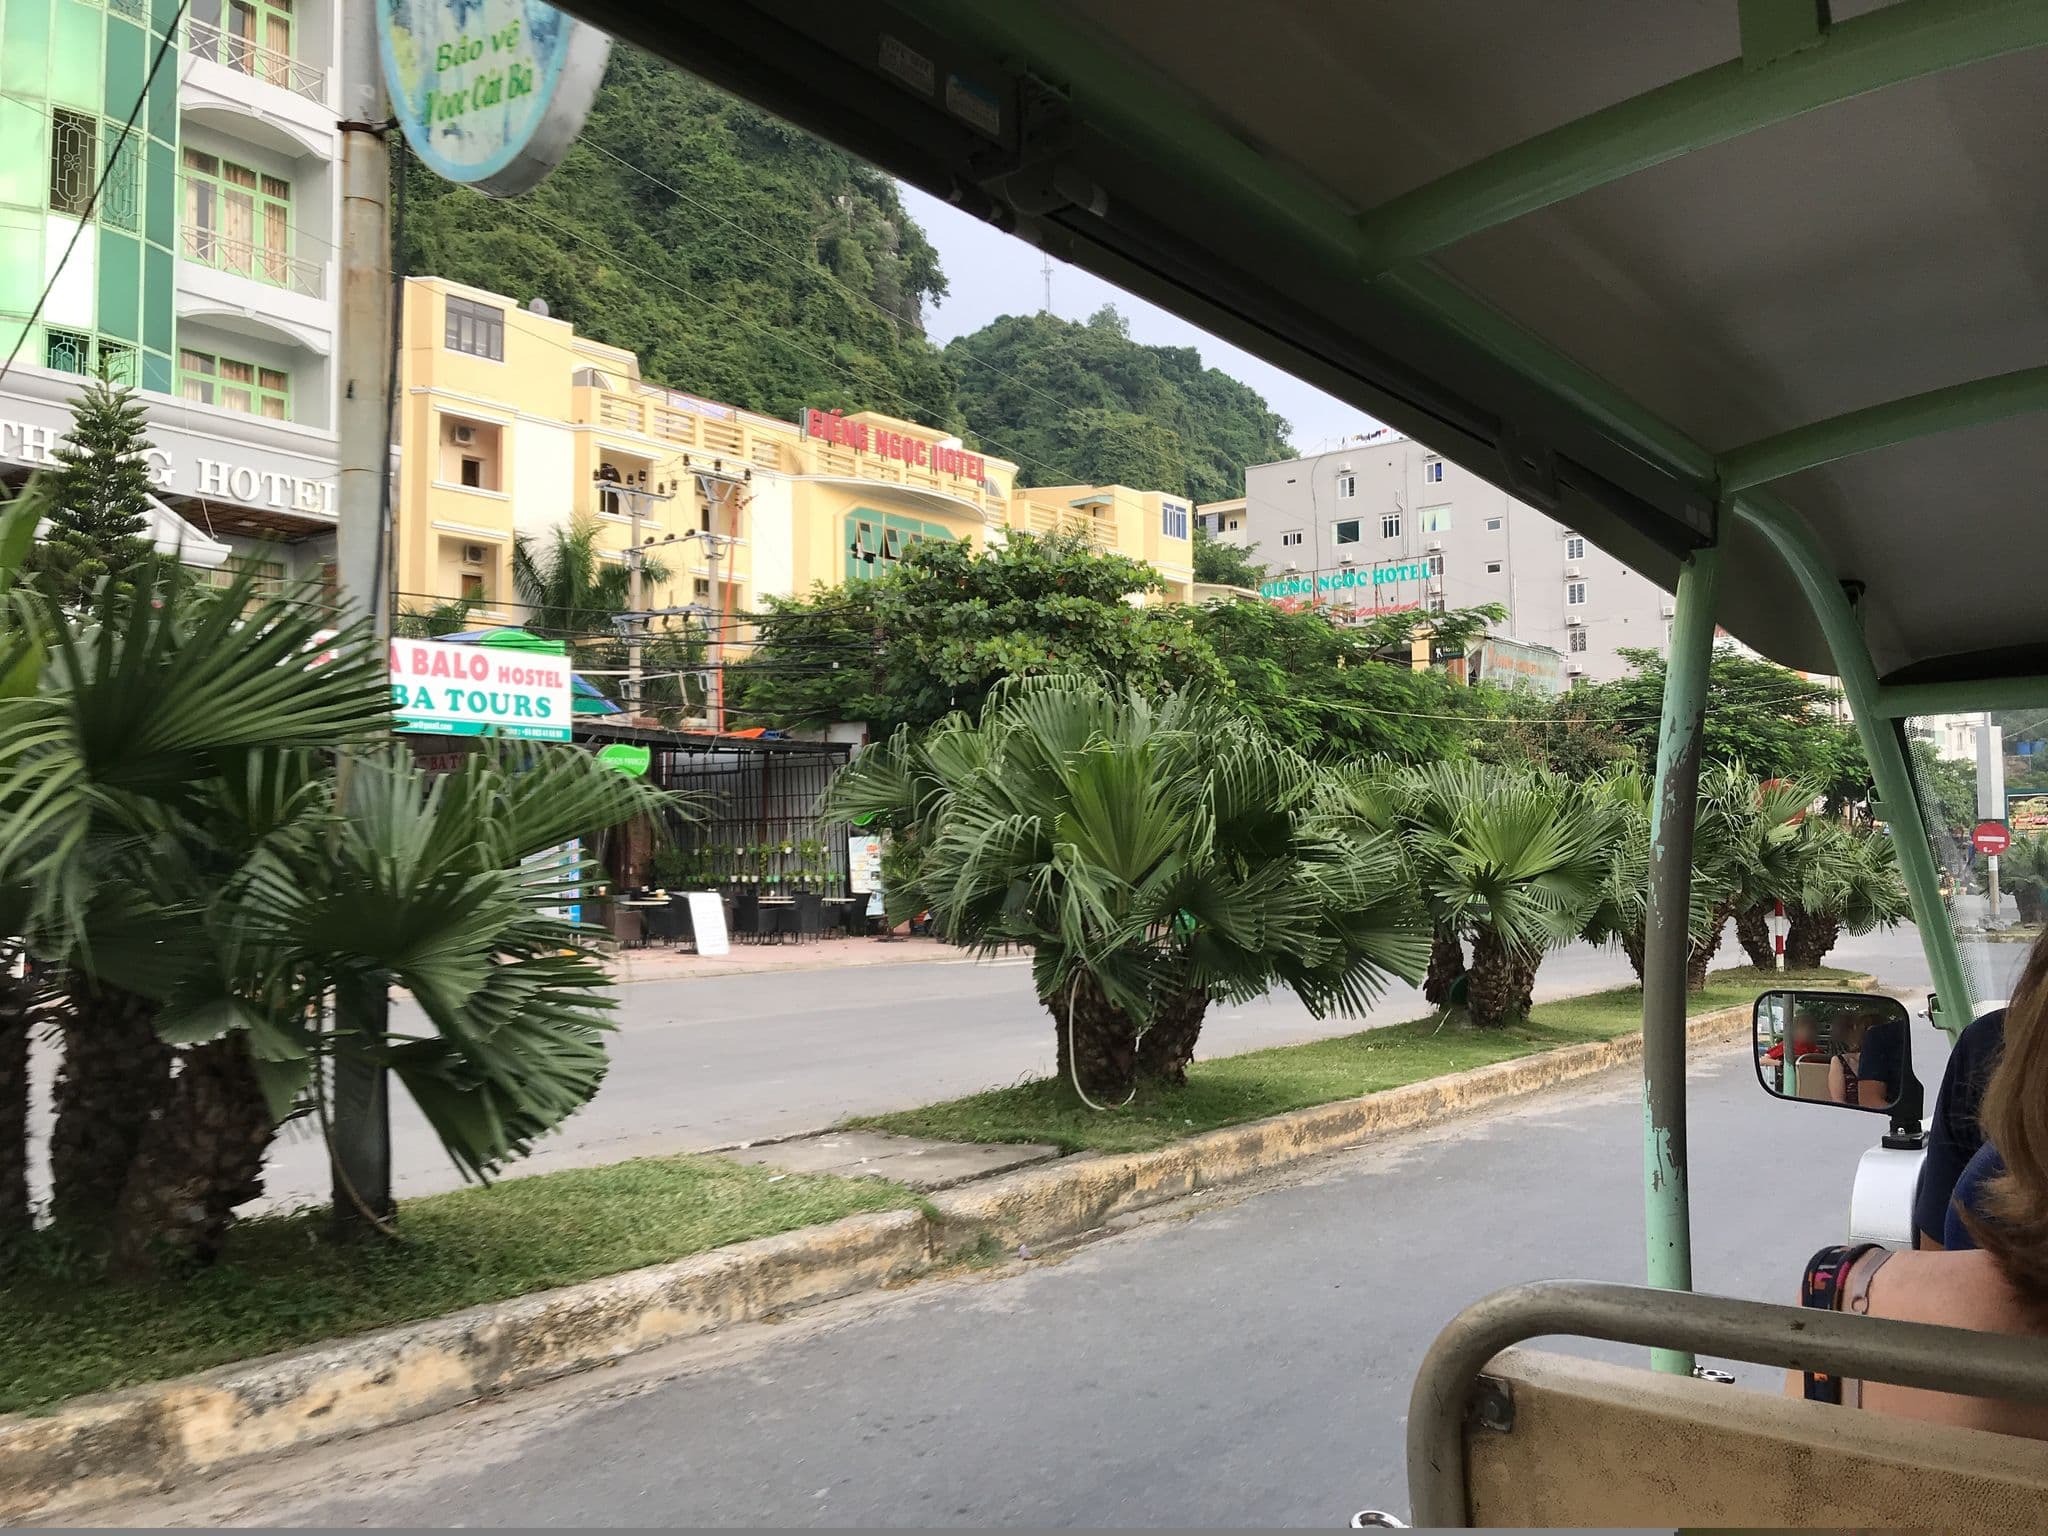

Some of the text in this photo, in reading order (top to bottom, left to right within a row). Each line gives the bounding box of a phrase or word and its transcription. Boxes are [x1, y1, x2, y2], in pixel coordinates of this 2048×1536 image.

[932, 446, 985, 481] HOTEL
[196, 457, 338, 516] HOTEL
[1373, 563, 1432, 585] HOTEL
[412, 647, 489, 681] BALO
[498, 666, 563, 688] HOSTEL
[444, 687, 552, 718] TOURS
